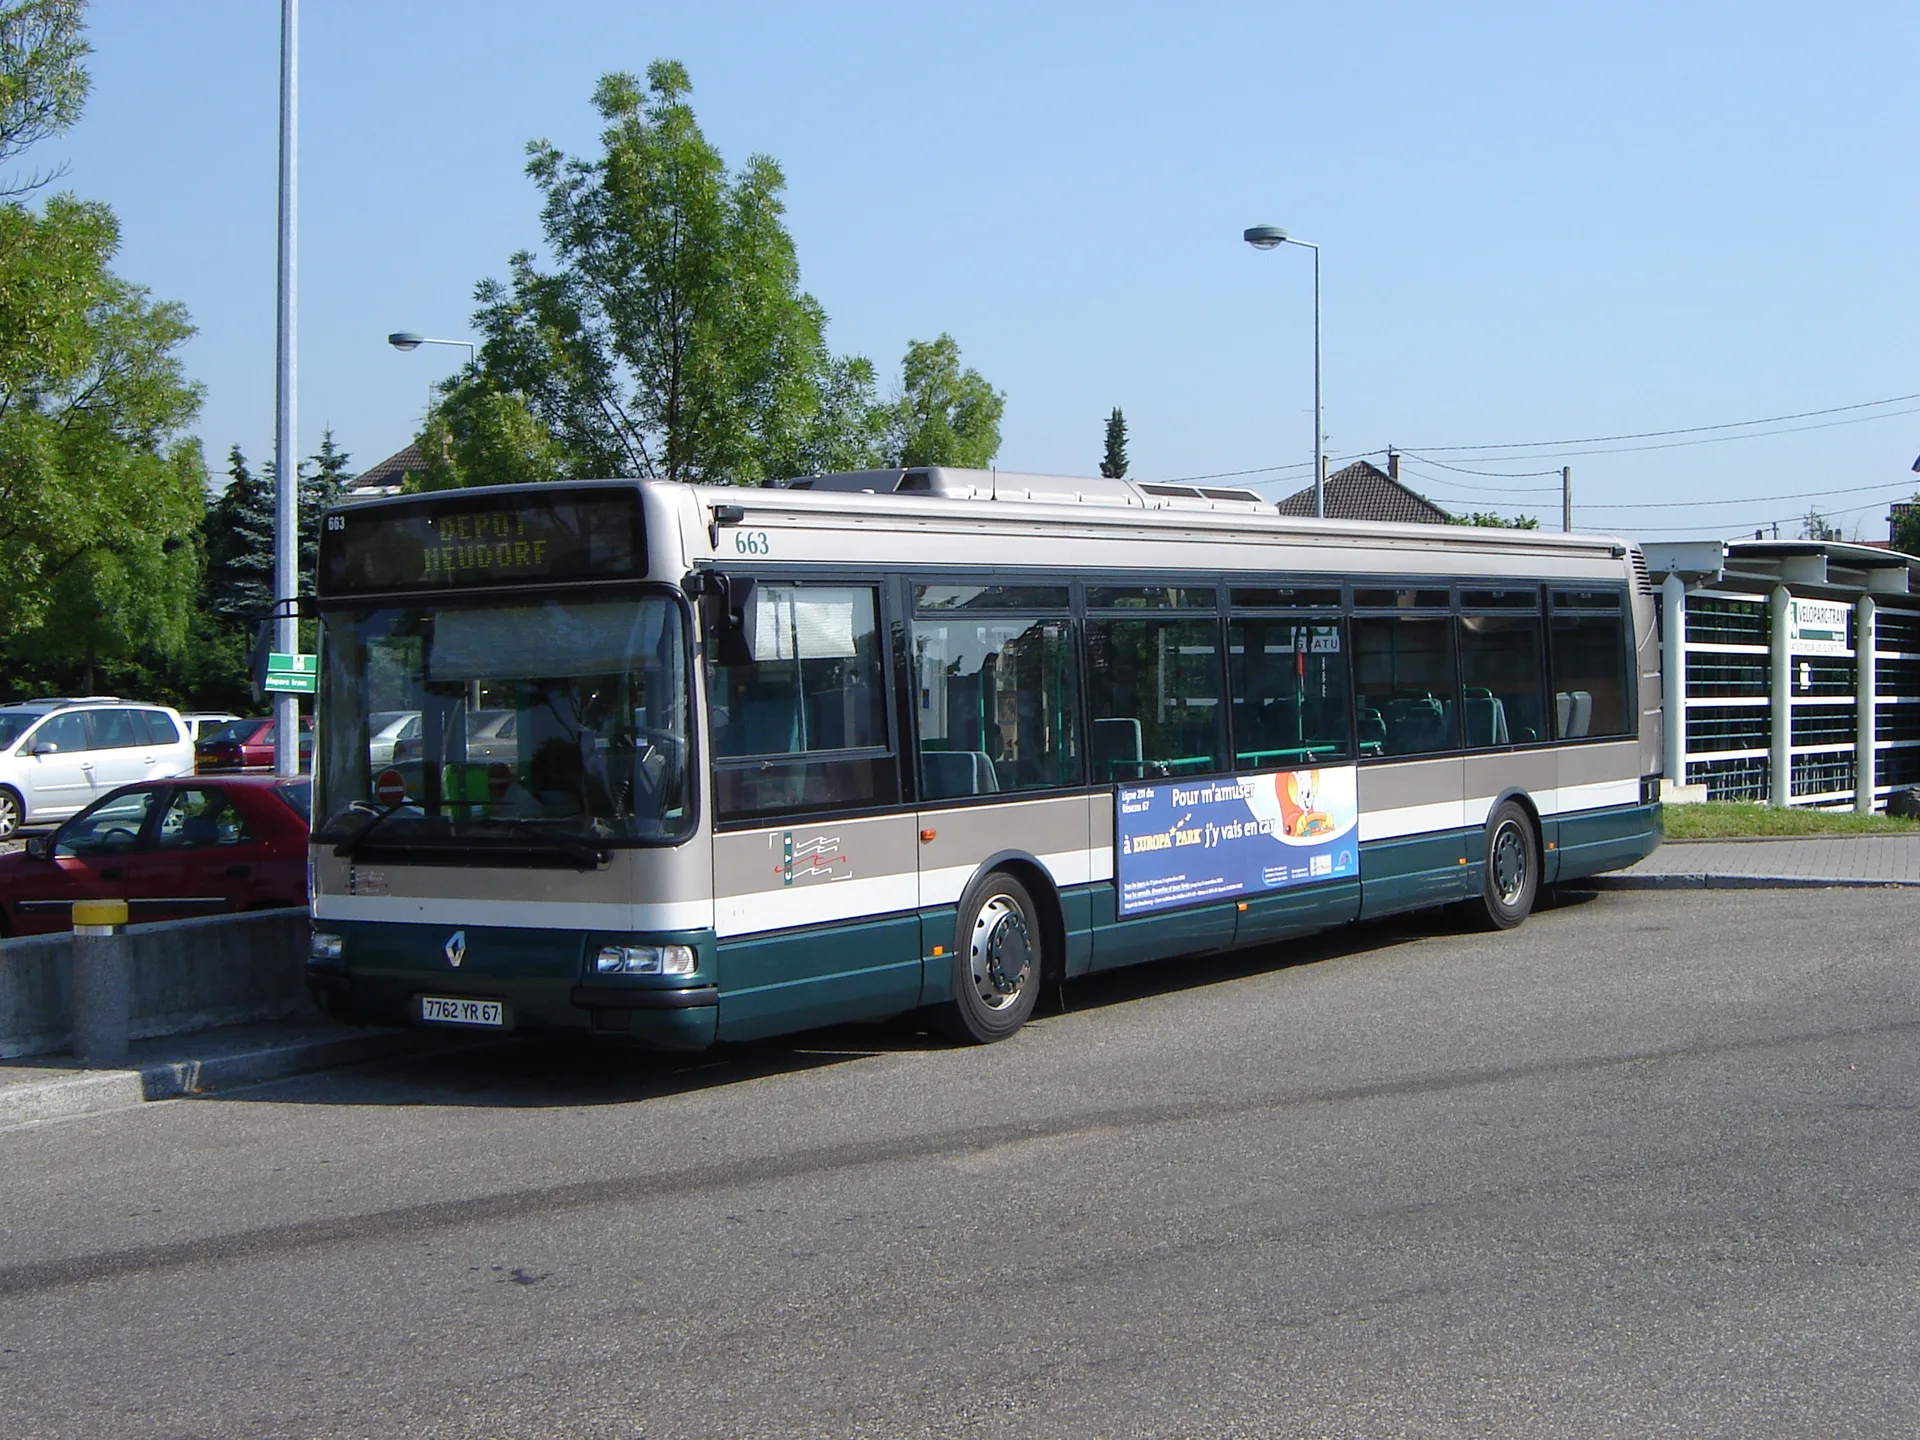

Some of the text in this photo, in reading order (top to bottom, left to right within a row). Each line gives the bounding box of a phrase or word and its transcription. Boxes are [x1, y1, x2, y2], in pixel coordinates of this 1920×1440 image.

[328, 516, 345, 531] 663
[439, 512, 526, 541] DEPOT
[735, 531, 769, 555] 663
[423, 540, 547, 572] NEUDORF
[1141, 801, 1150, 811] 67
[1172, 782, 1256, 808] Pour m'amuser
[1123, 834, 1132, 855] à
[1204, 822, 1220, 848] j'y
[1220, 819, 1243, 840] vais
[1243, 821, 1259, 837] en
[1258, 818, 1276, 835] car
[426, 1000, 499, 1021] 7762 YR 67
